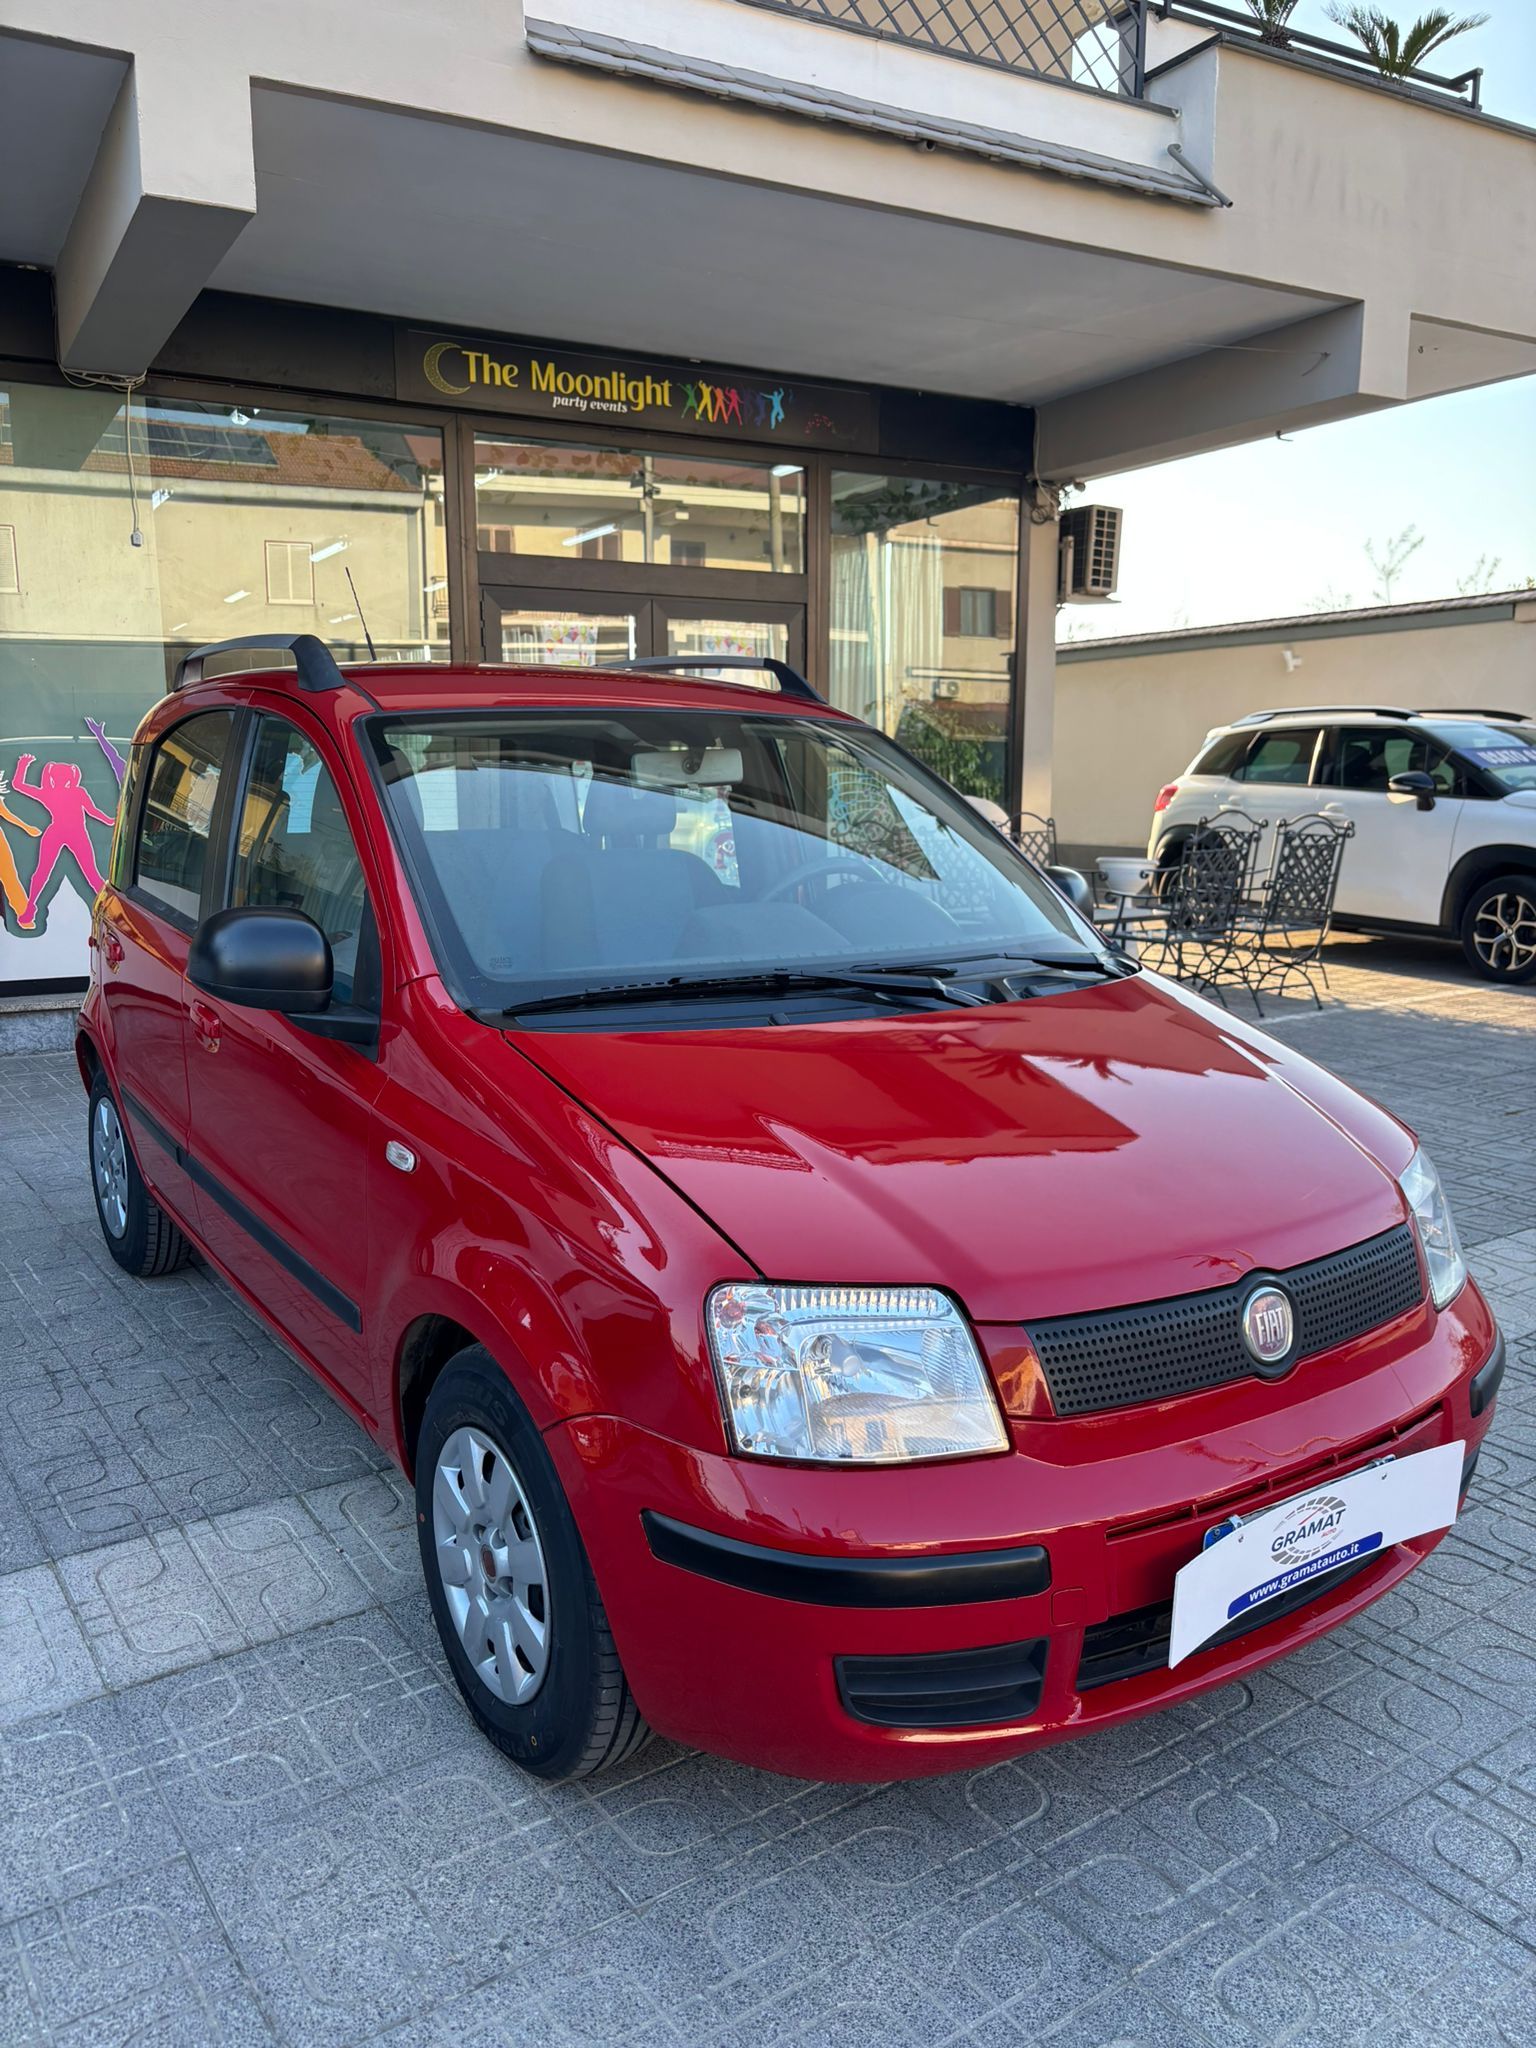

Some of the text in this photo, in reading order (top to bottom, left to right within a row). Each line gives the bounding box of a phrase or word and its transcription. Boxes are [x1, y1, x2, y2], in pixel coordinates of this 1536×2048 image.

[462, 350, 673, 412] The Moonlight
[552, 395, 628, 413] party events
[1255, 1307, 1284, 1345] FIAT
[1271, 1508, 1347, 1552] GRAMAT
[1249, 1543, 1360, 1602] www.gramatauto.it
